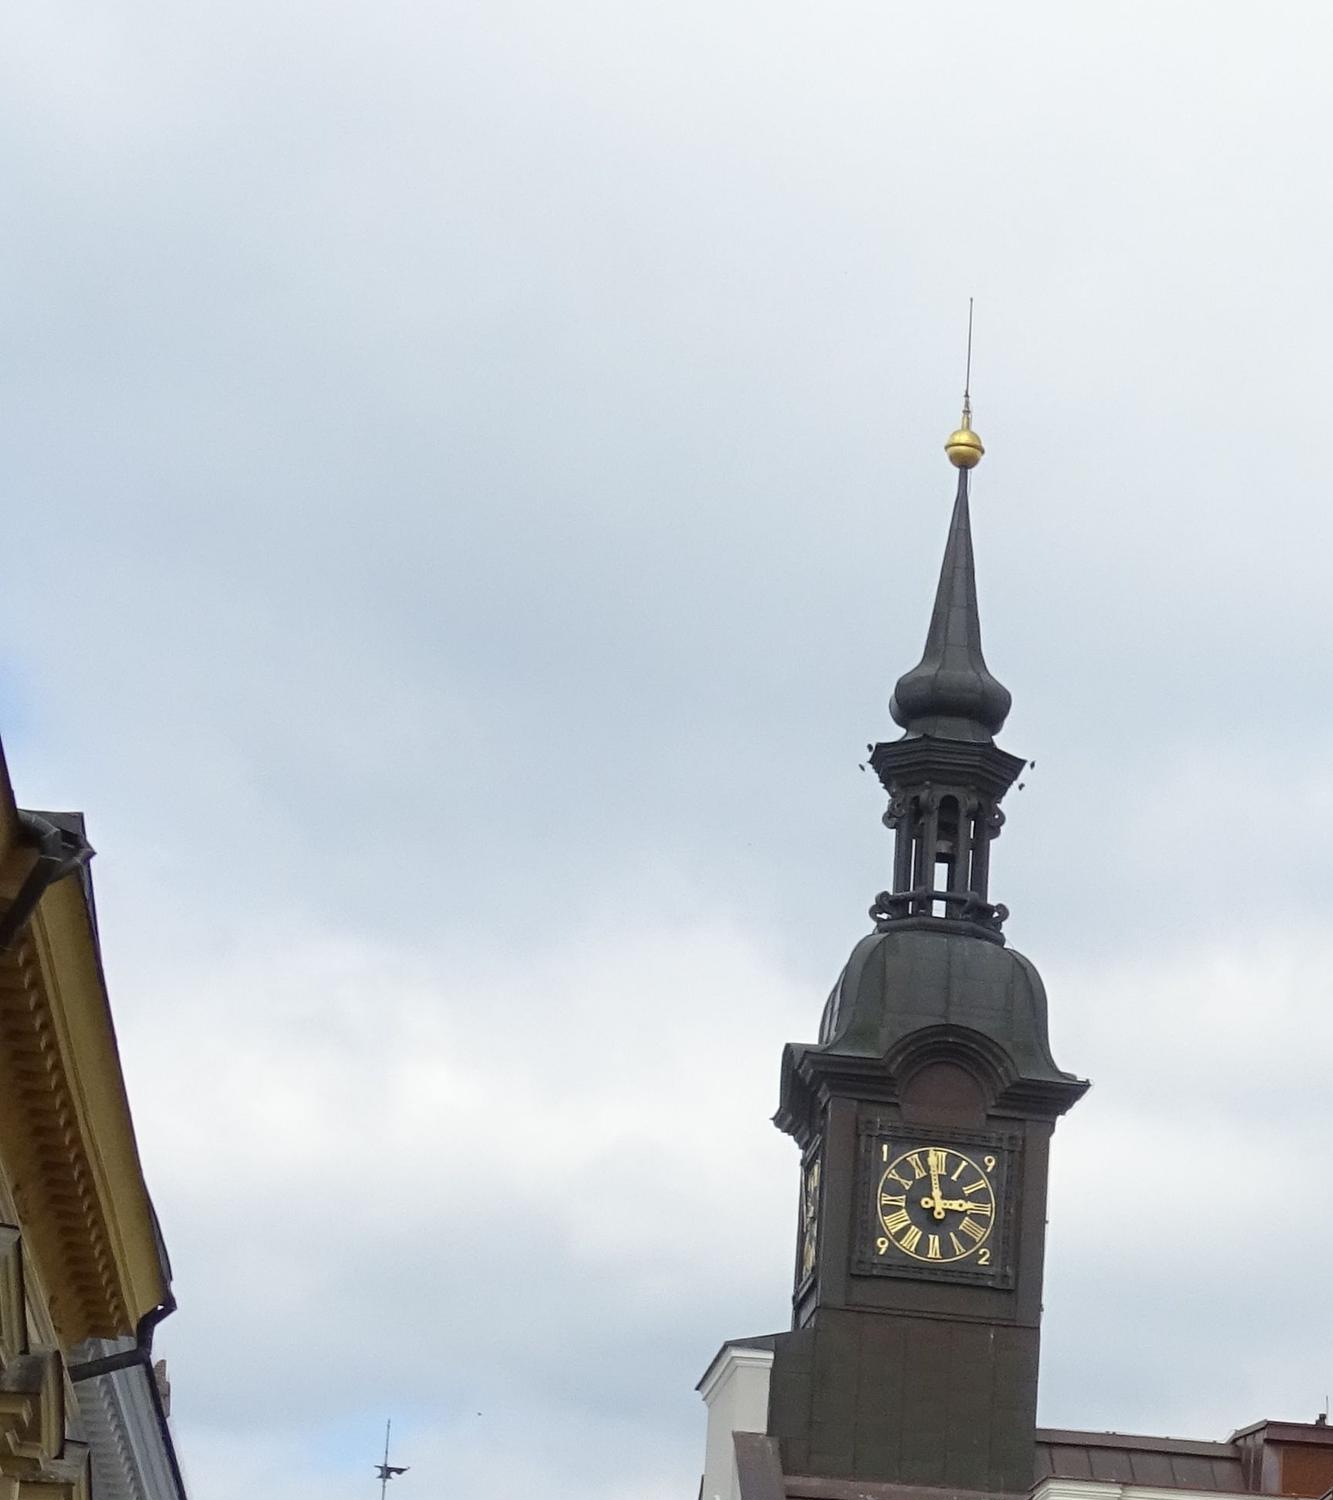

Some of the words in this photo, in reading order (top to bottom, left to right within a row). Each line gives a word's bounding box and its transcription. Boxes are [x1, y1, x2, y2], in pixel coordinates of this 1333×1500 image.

[984, 1155, 996, 1173] 9
[876, 1237, 889, 1255] 9
[977, 1248, 990, 1265] 2
